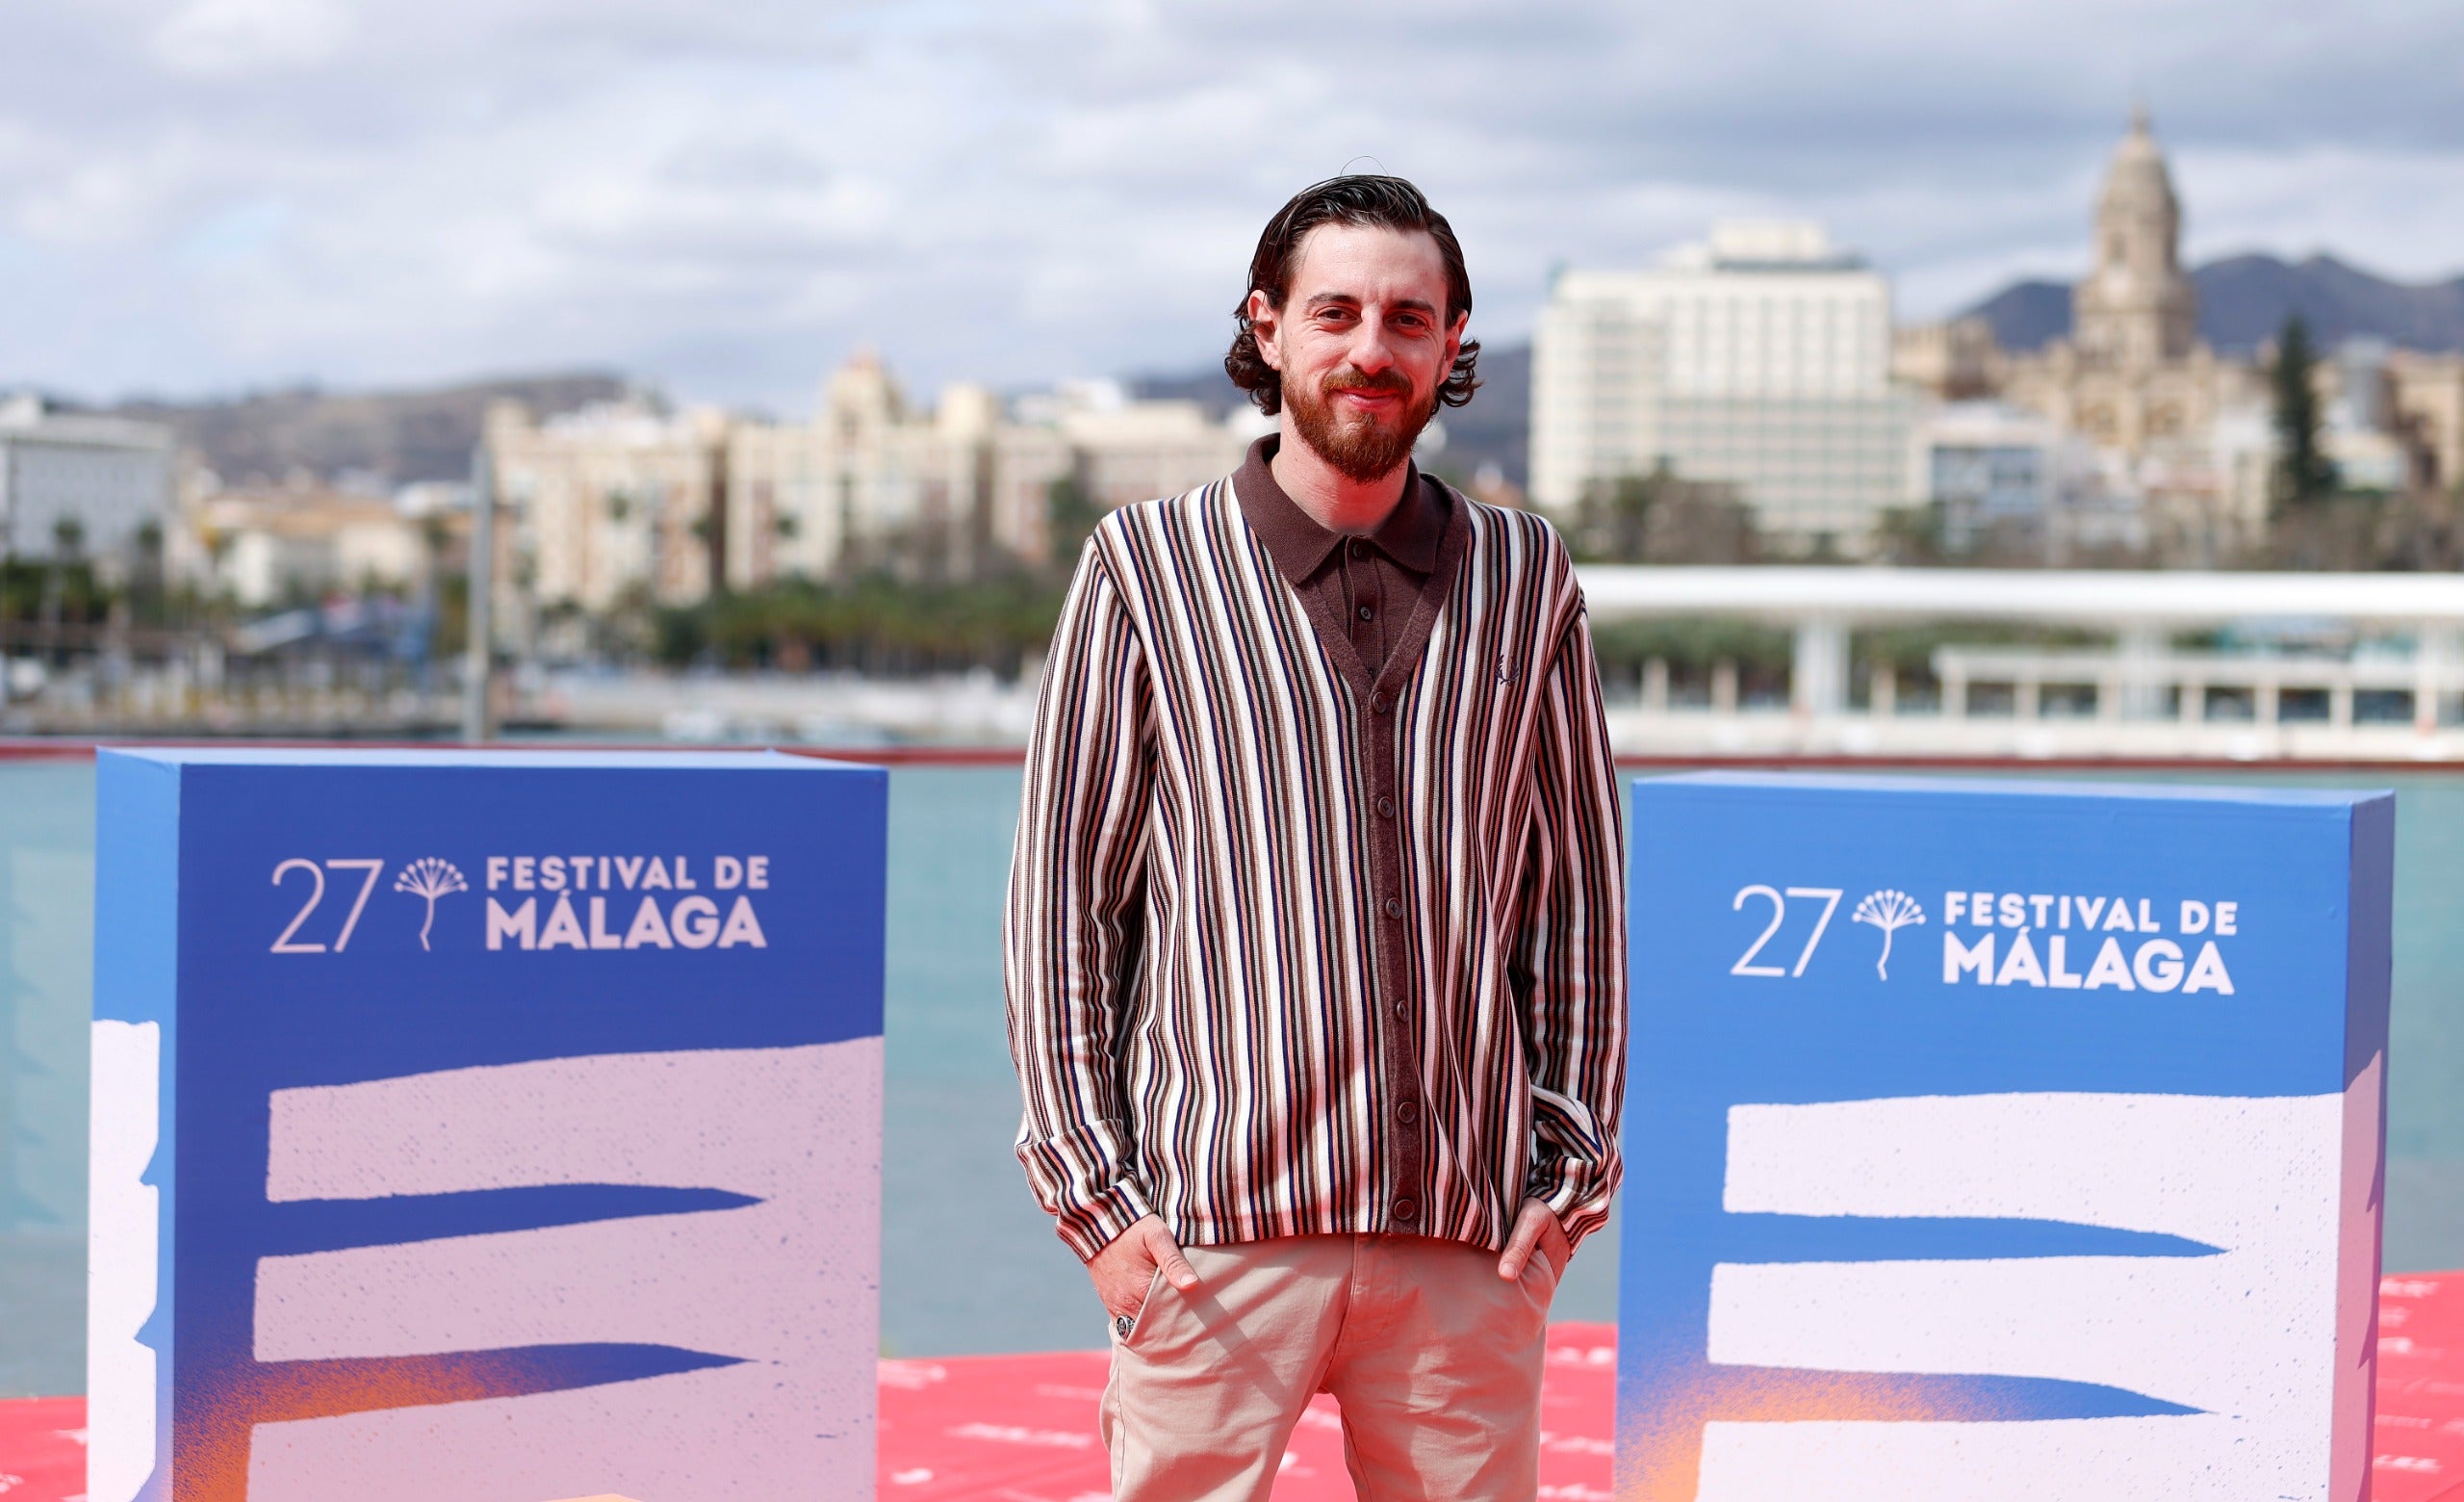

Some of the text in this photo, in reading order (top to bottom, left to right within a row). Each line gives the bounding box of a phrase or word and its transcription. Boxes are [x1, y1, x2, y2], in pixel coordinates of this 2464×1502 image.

[270, 858, 384, 952] 27
[486, 856, 769, 891] FESTIVAL DE
[486, 889, 768, 950] MÁLAGA
[1731, 885, 1843, 977] 27
[1944, 891, 2238, 935] FESTIVAL DE
[1943, 925, 2235, 996] MÁLAGA
